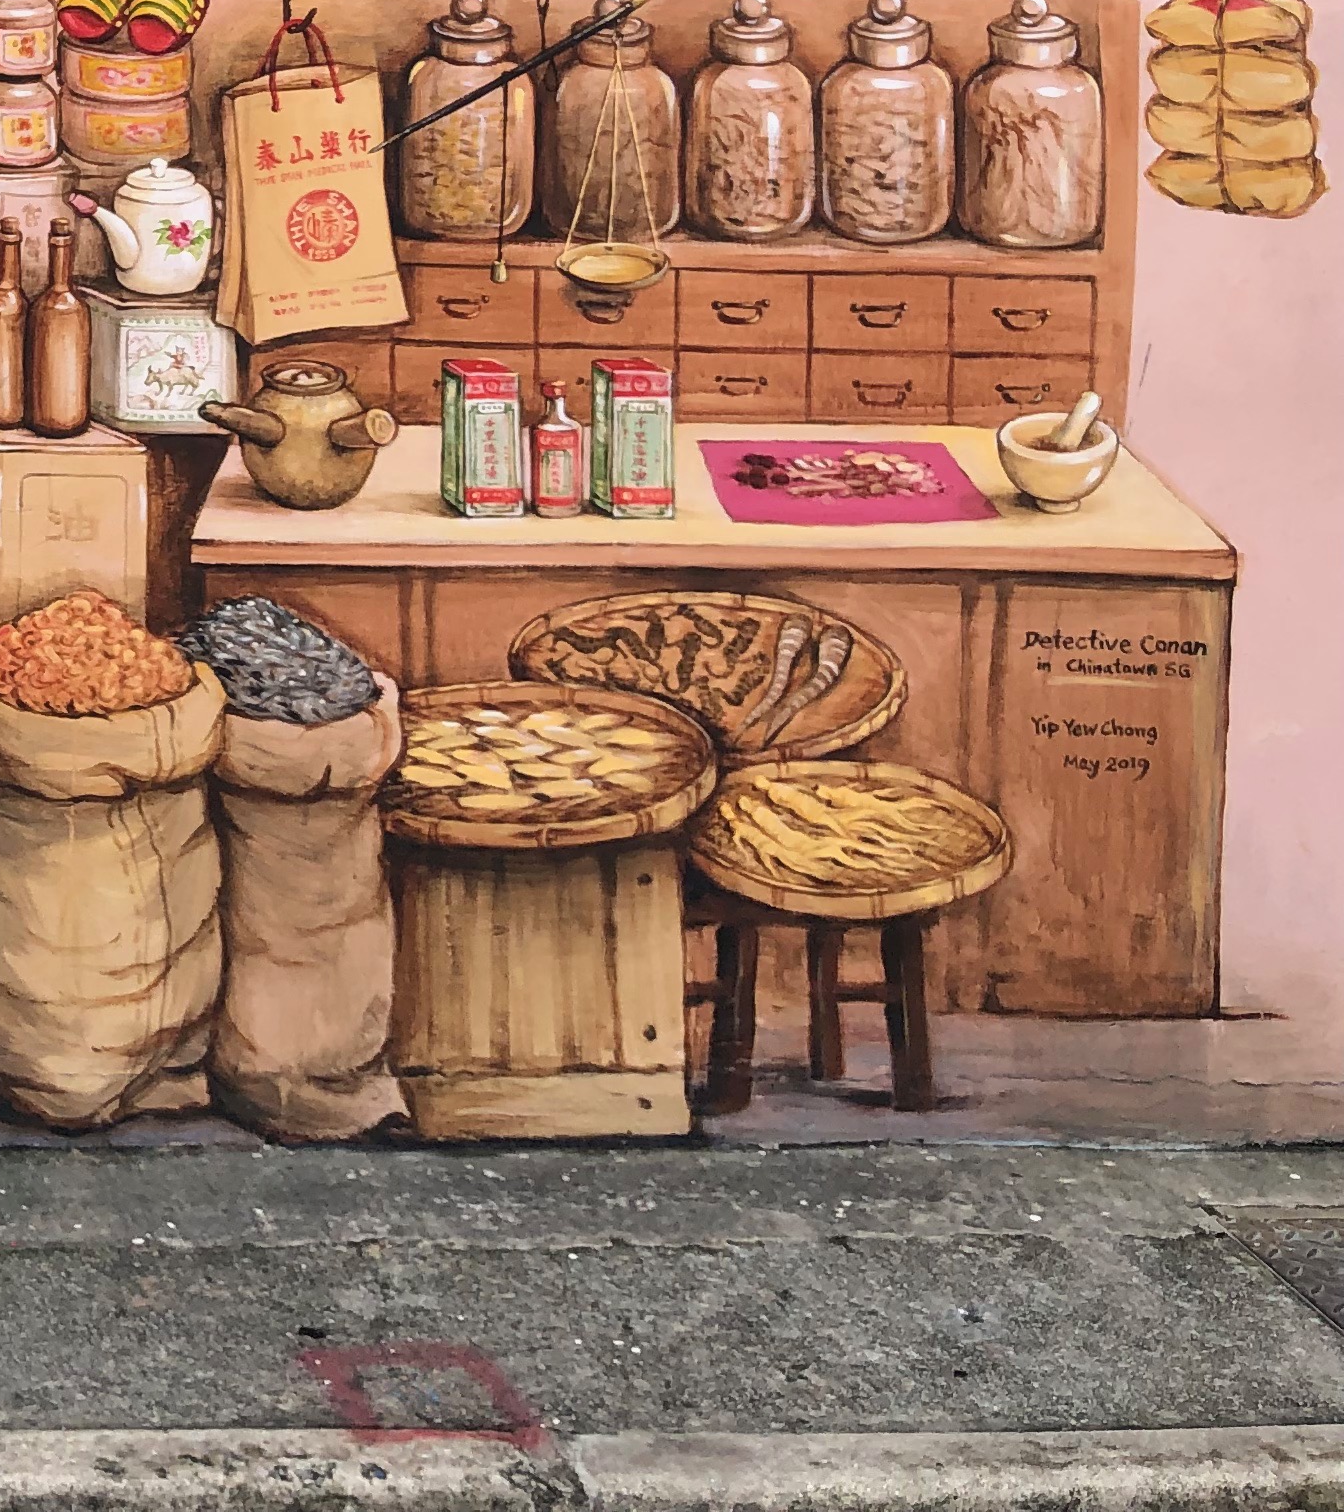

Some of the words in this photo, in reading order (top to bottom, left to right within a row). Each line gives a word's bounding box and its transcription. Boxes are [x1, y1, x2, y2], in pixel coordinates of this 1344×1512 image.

[289, 198, 312, 250] THYE
[326, 192, 358, 247] SHAN
[1020, 629, 1132, 654] Detective
[1140, 635, 1208, 656] Conan
[1037, 656, 1051, 672] in
[1066, 658, 1158, 676] Chinatown
[1164, 662, 1191, 678] SG
[1031, 715, 1060, 739] Yip
[1062, 718, 1098, 737] Yew
[1101, 718, 1158, 746] Chong
[1063, 755, 1100, 780] May
[1104, 757, 1150, 782] 2019
